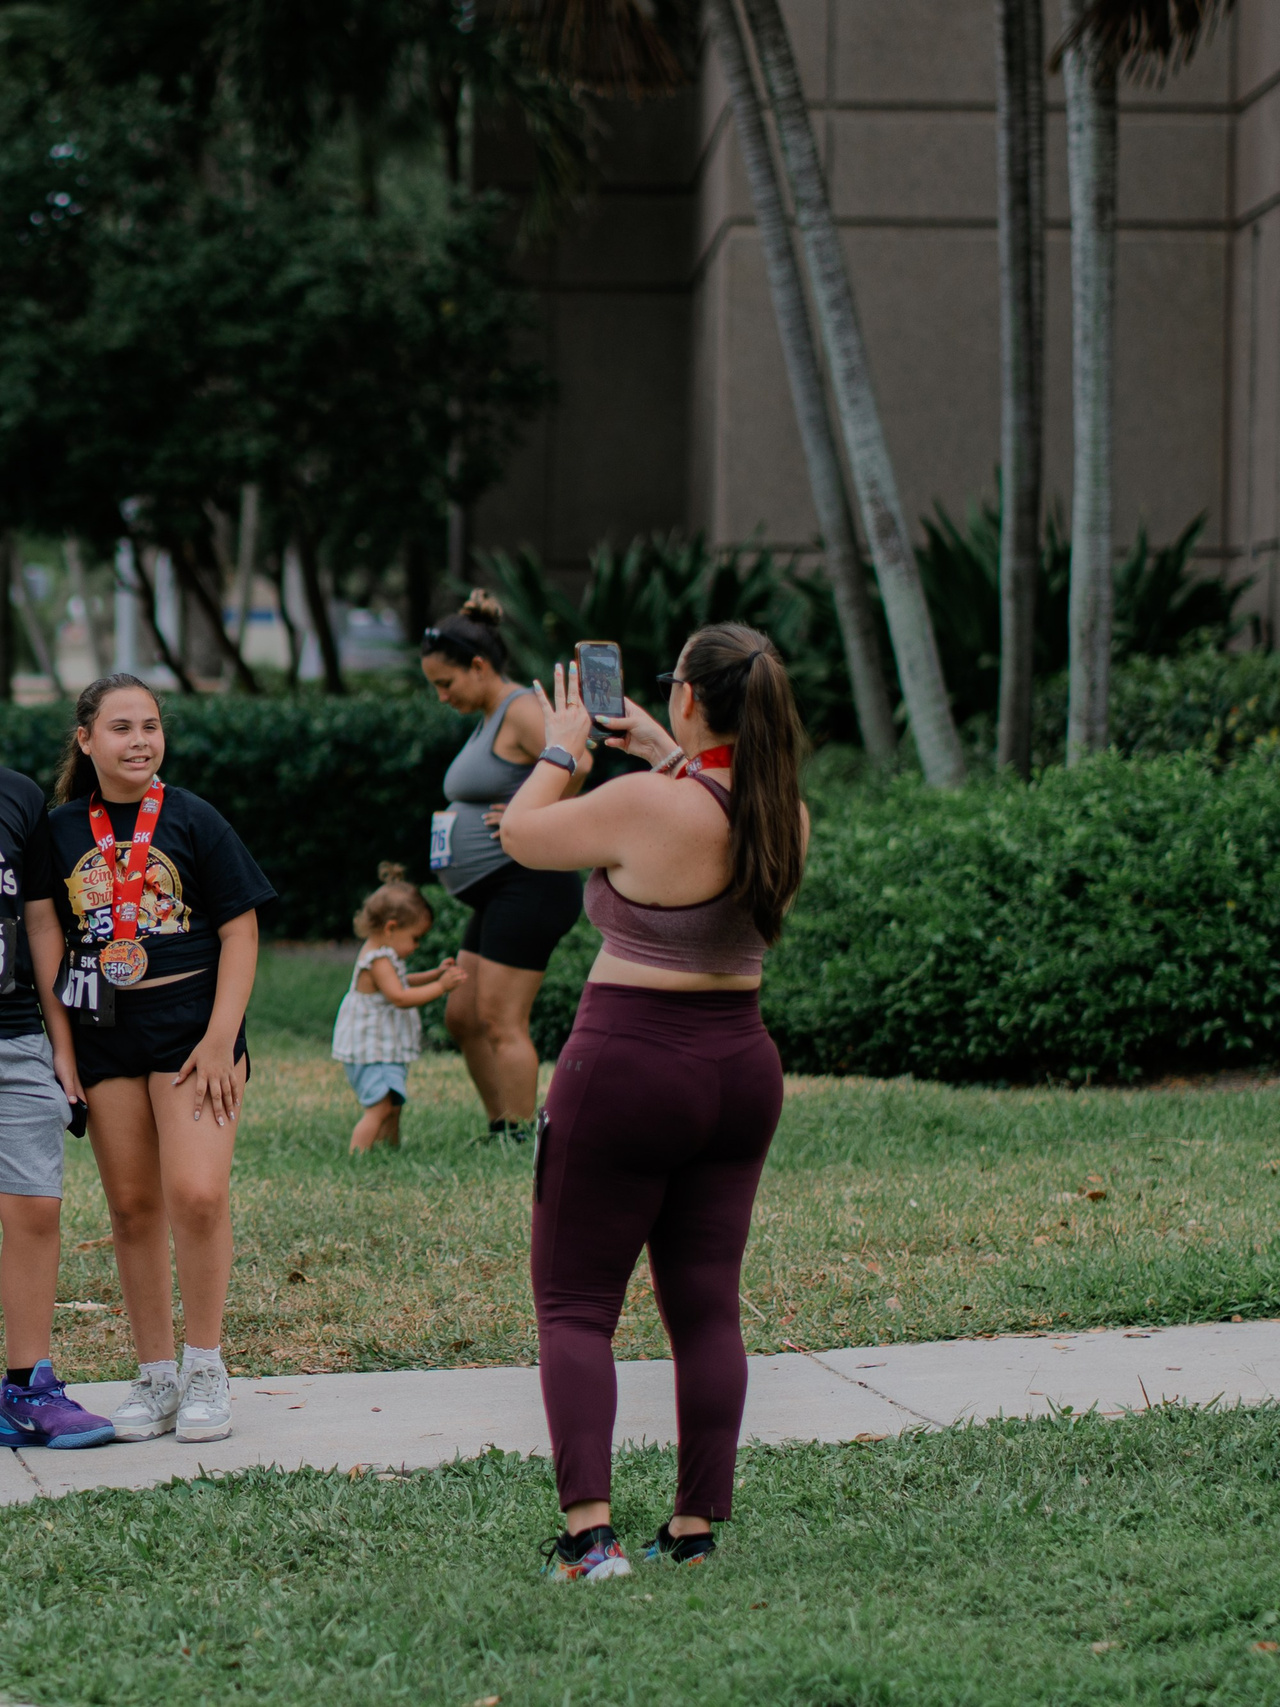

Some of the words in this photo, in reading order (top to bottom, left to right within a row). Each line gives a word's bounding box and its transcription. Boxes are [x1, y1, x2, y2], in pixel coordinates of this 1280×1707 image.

[133, 832, 151, 843] 5K
[83, 869, 113, 886] Cin
[96, 908, 114, 935] 5
[81, 956, 97, 969] 5K
[111, 962, 126, 975] 5K
[62, 968, 98, 1010] 671
